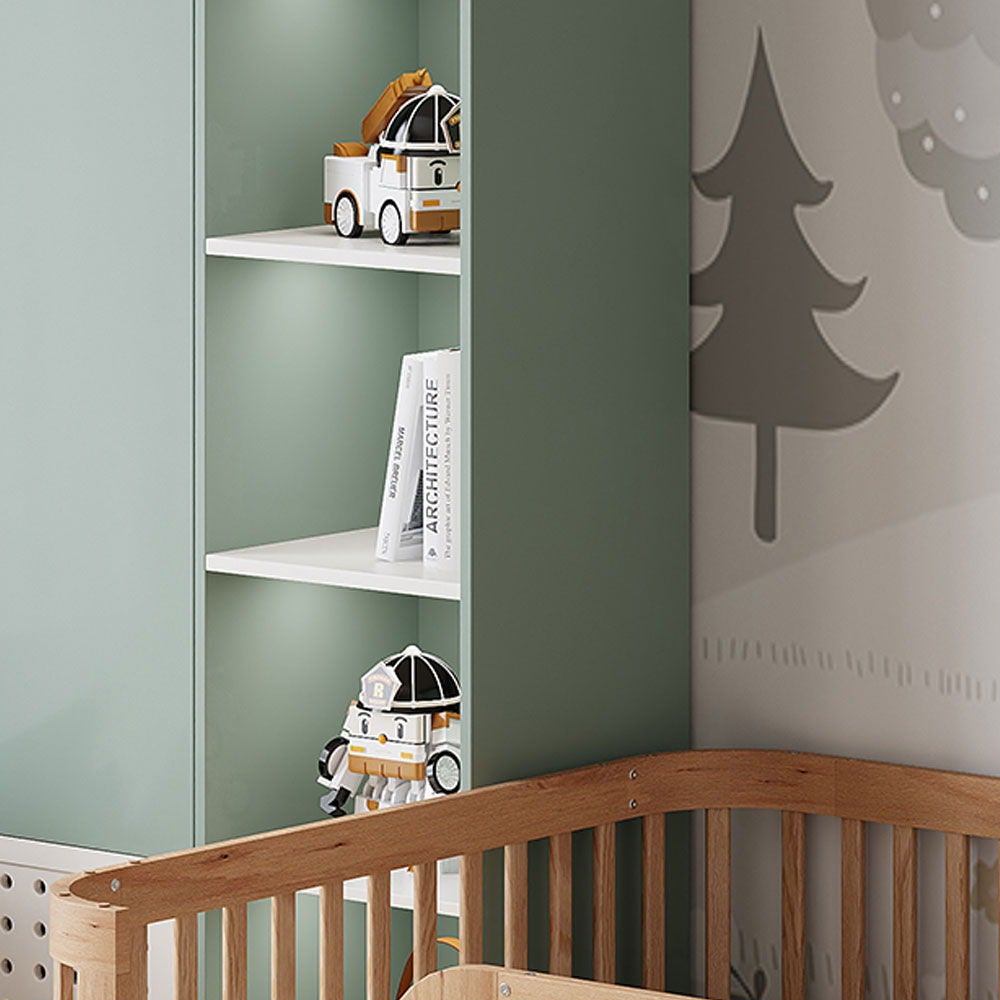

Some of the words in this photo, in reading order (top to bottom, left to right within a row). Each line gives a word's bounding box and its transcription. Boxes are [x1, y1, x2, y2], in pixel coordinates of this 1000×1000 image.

[393, 426, 406, 461] MARCEL
[426, 378, 439, 534] ARCHITECTURE
[388, 463, 400, 499] BREUER
